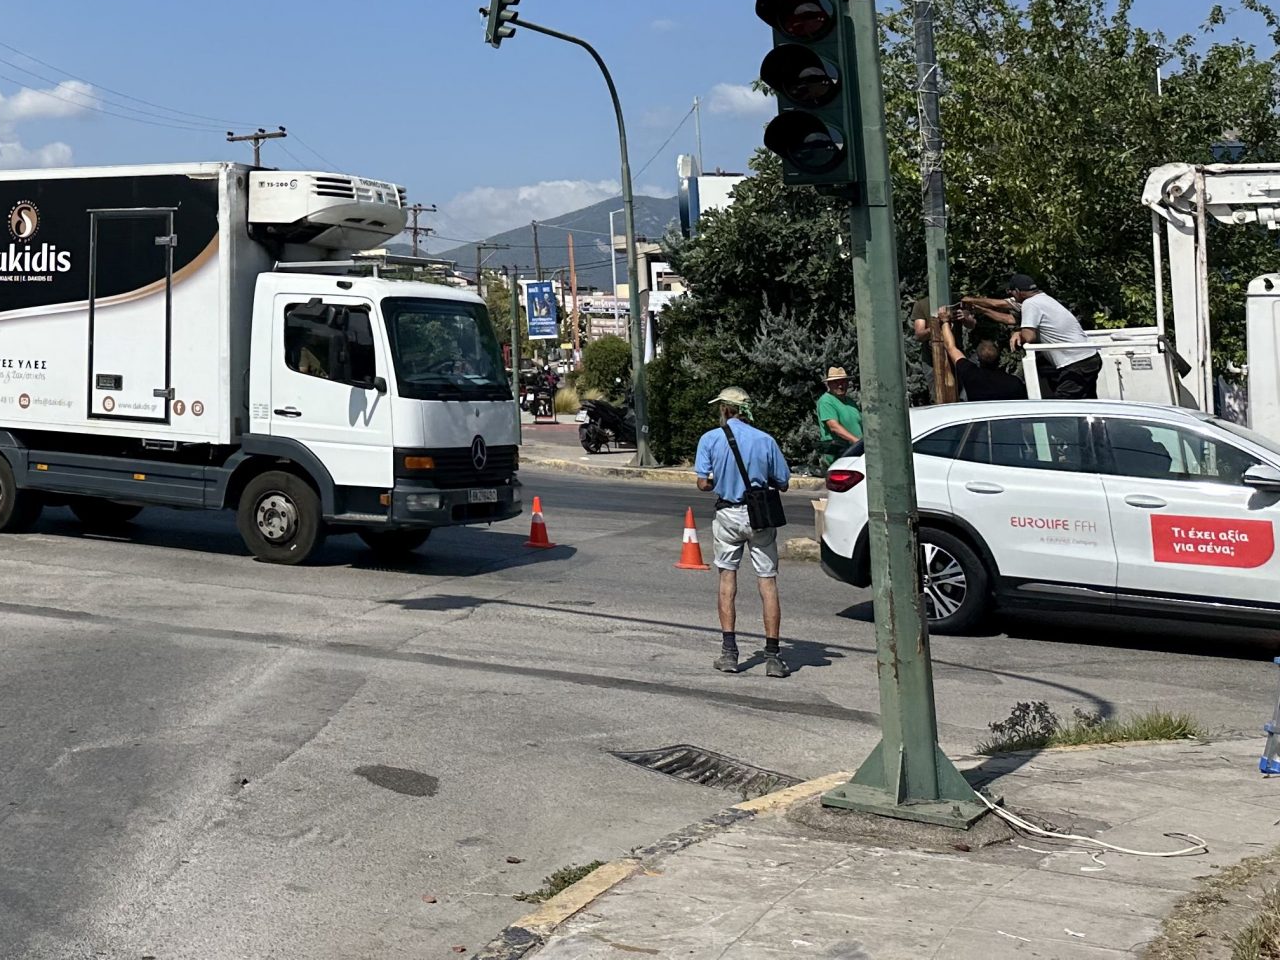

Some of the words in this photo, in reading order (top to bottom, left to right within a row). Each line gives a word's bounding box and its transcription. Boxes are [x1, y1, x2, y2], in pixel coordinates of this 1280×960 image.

[18, 359, 47, 370] ΥΛΕΣ
[1010, 516, 1070, 531] EUROLIFE
[1074, 520, 1097, 533] FFH
[1171, 527, 1185, 538] Τι
[1188, 527, 1216, 540] έχει
[1218, 529, 1249, 543] αξία
[1173, 542, 1195, 554] για
[1197, 541, 1235, 557] σένα;
